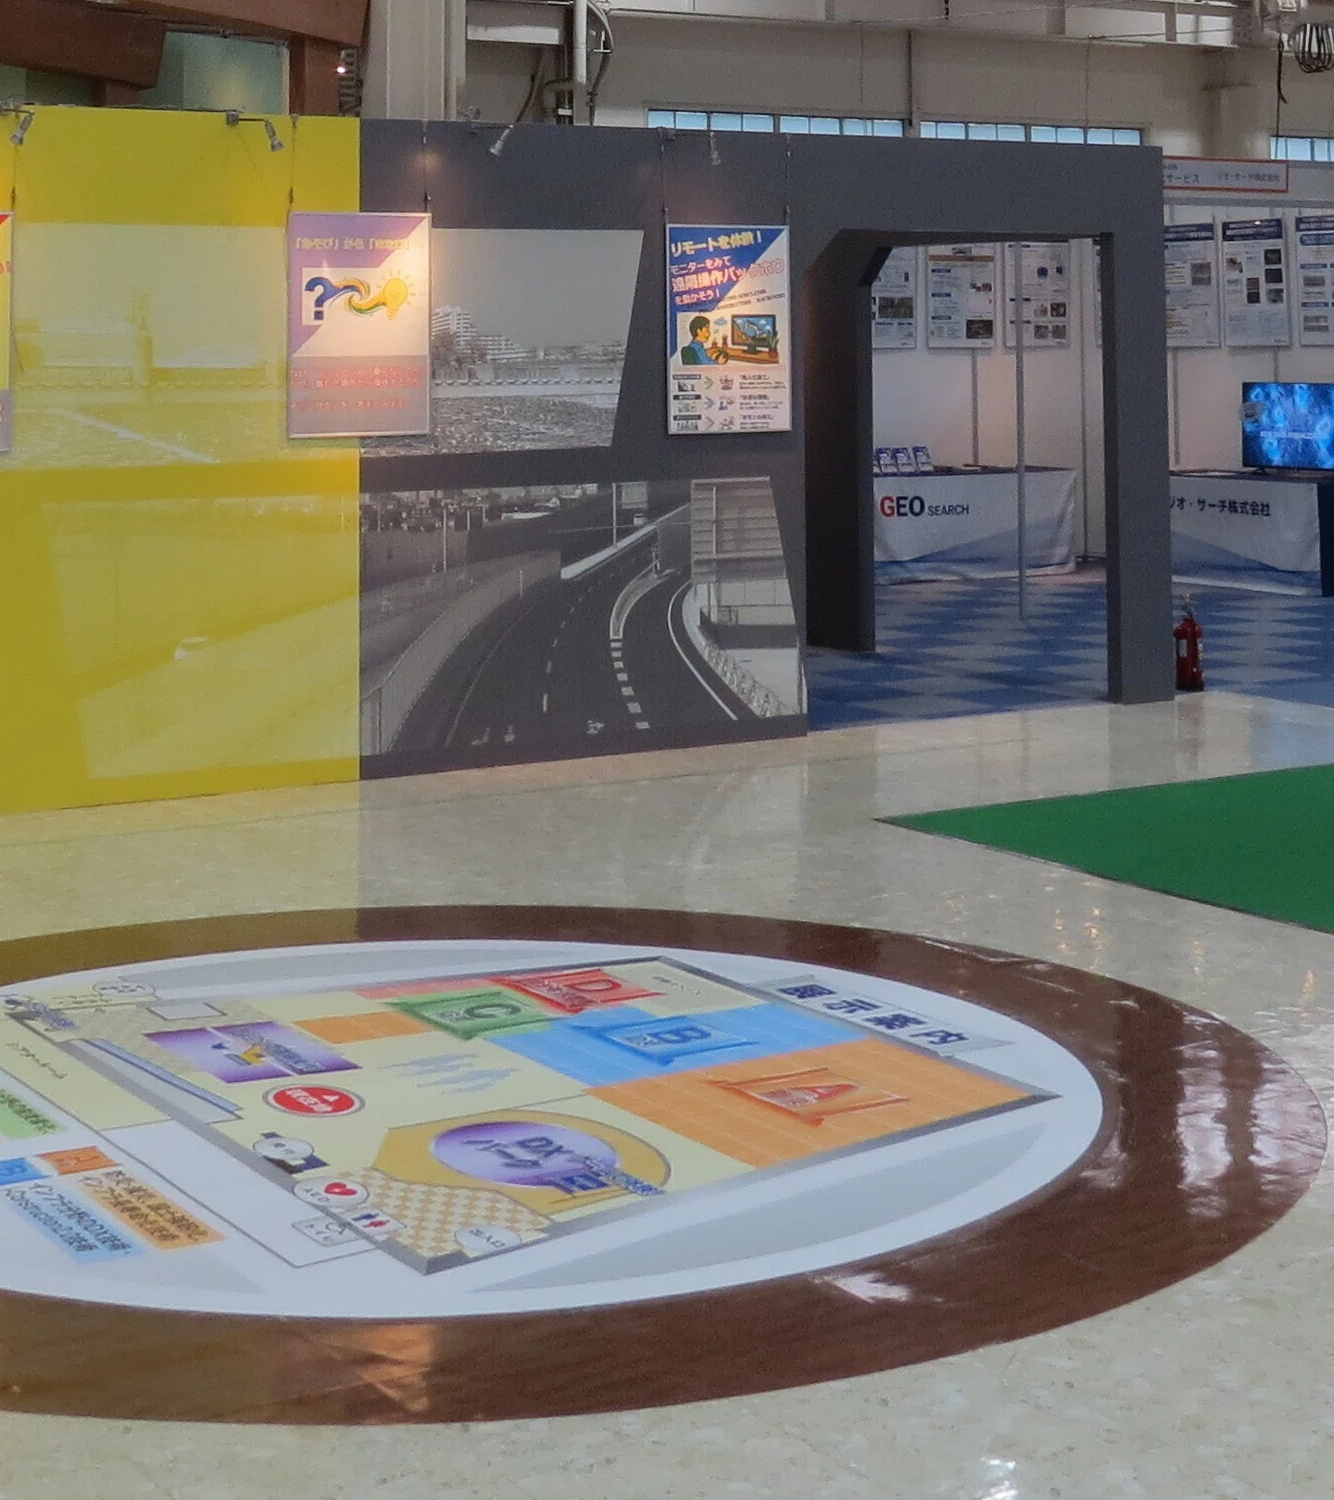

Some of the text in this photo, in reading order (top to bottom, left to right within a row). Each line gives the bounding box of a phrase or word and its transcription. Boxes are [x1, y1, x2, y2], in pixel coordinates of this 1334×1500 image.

[671, 230, 762, 257] リモートを体験！
[671, 256, 732, 275] モニターをみて
[672, 258, 785, 293] 遠隔操作バックホウ
[879, 495, 970, 518] GEO SEARCH
[777, 982, 970, 1046] 展示案内
